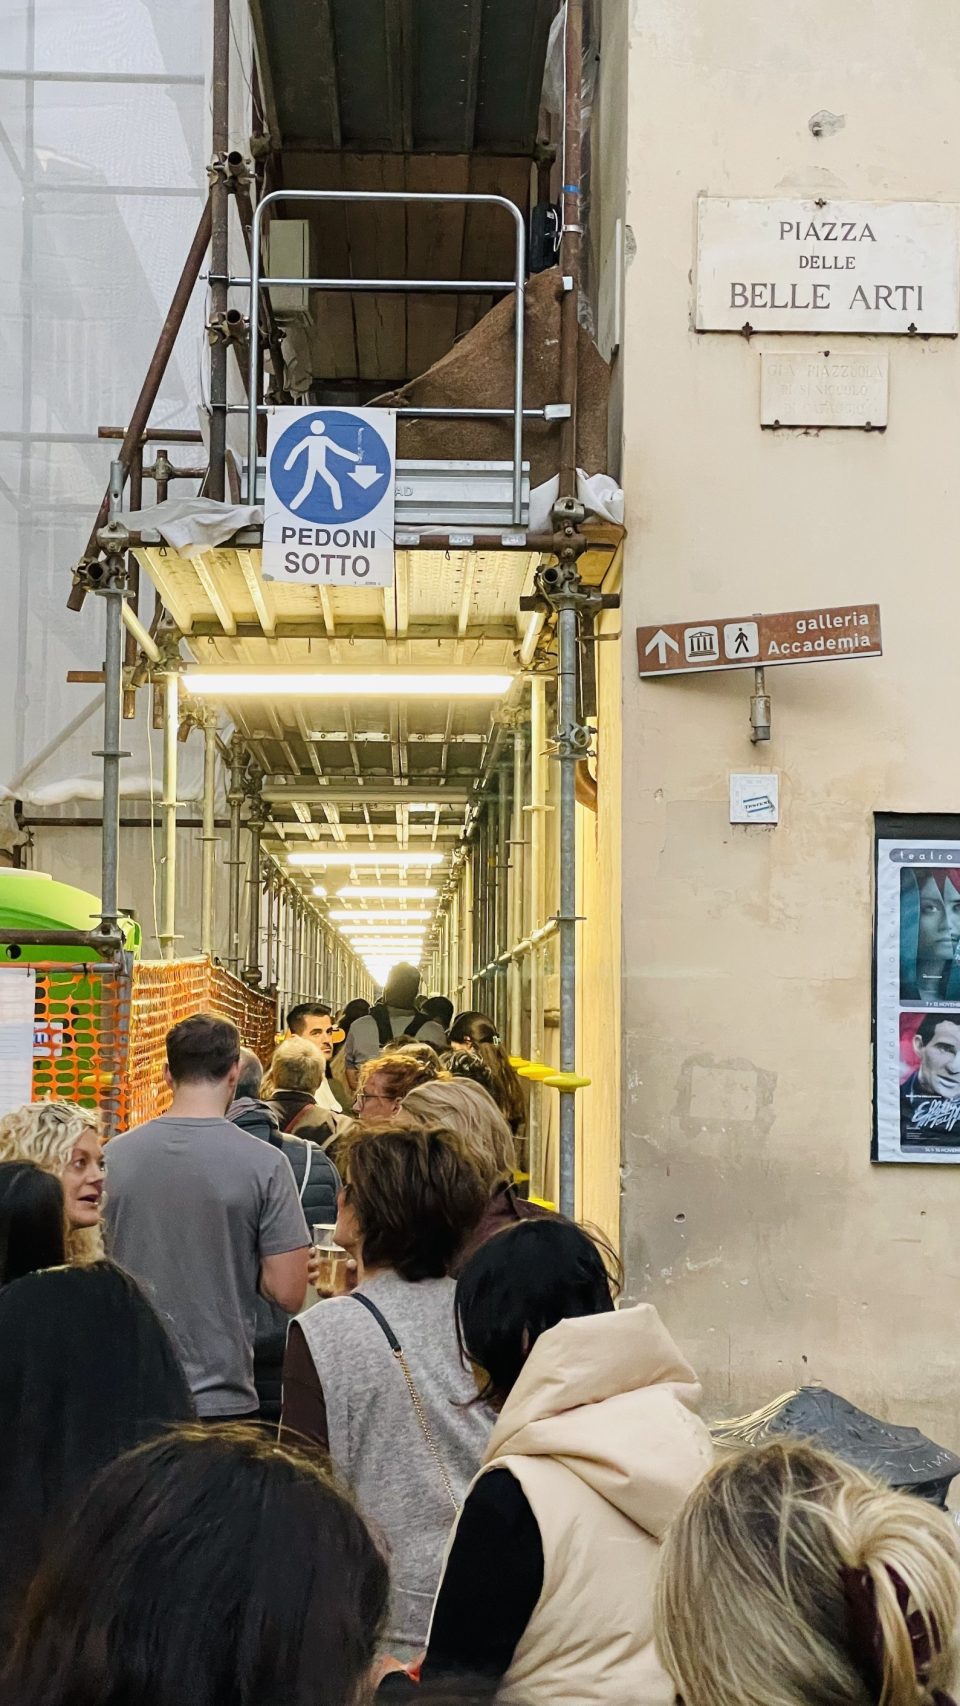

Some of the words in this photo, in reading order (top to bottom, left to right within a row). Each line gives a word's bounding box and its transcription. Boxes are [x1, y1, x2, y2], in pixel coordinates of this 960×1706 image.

[779, 221, 877, 242] PIAZZA
[799, 255, 856, 270] DELLE
[730, 282, 831, 309] BELLE
[849, 285, 923, 311] ARTI
[281, 526, 376, 549] PEDONI
[284, 552, 371, 578] SOTTO
[796, 612, 870, 635] galleria
[767, 634, 872, 656] Accademia
